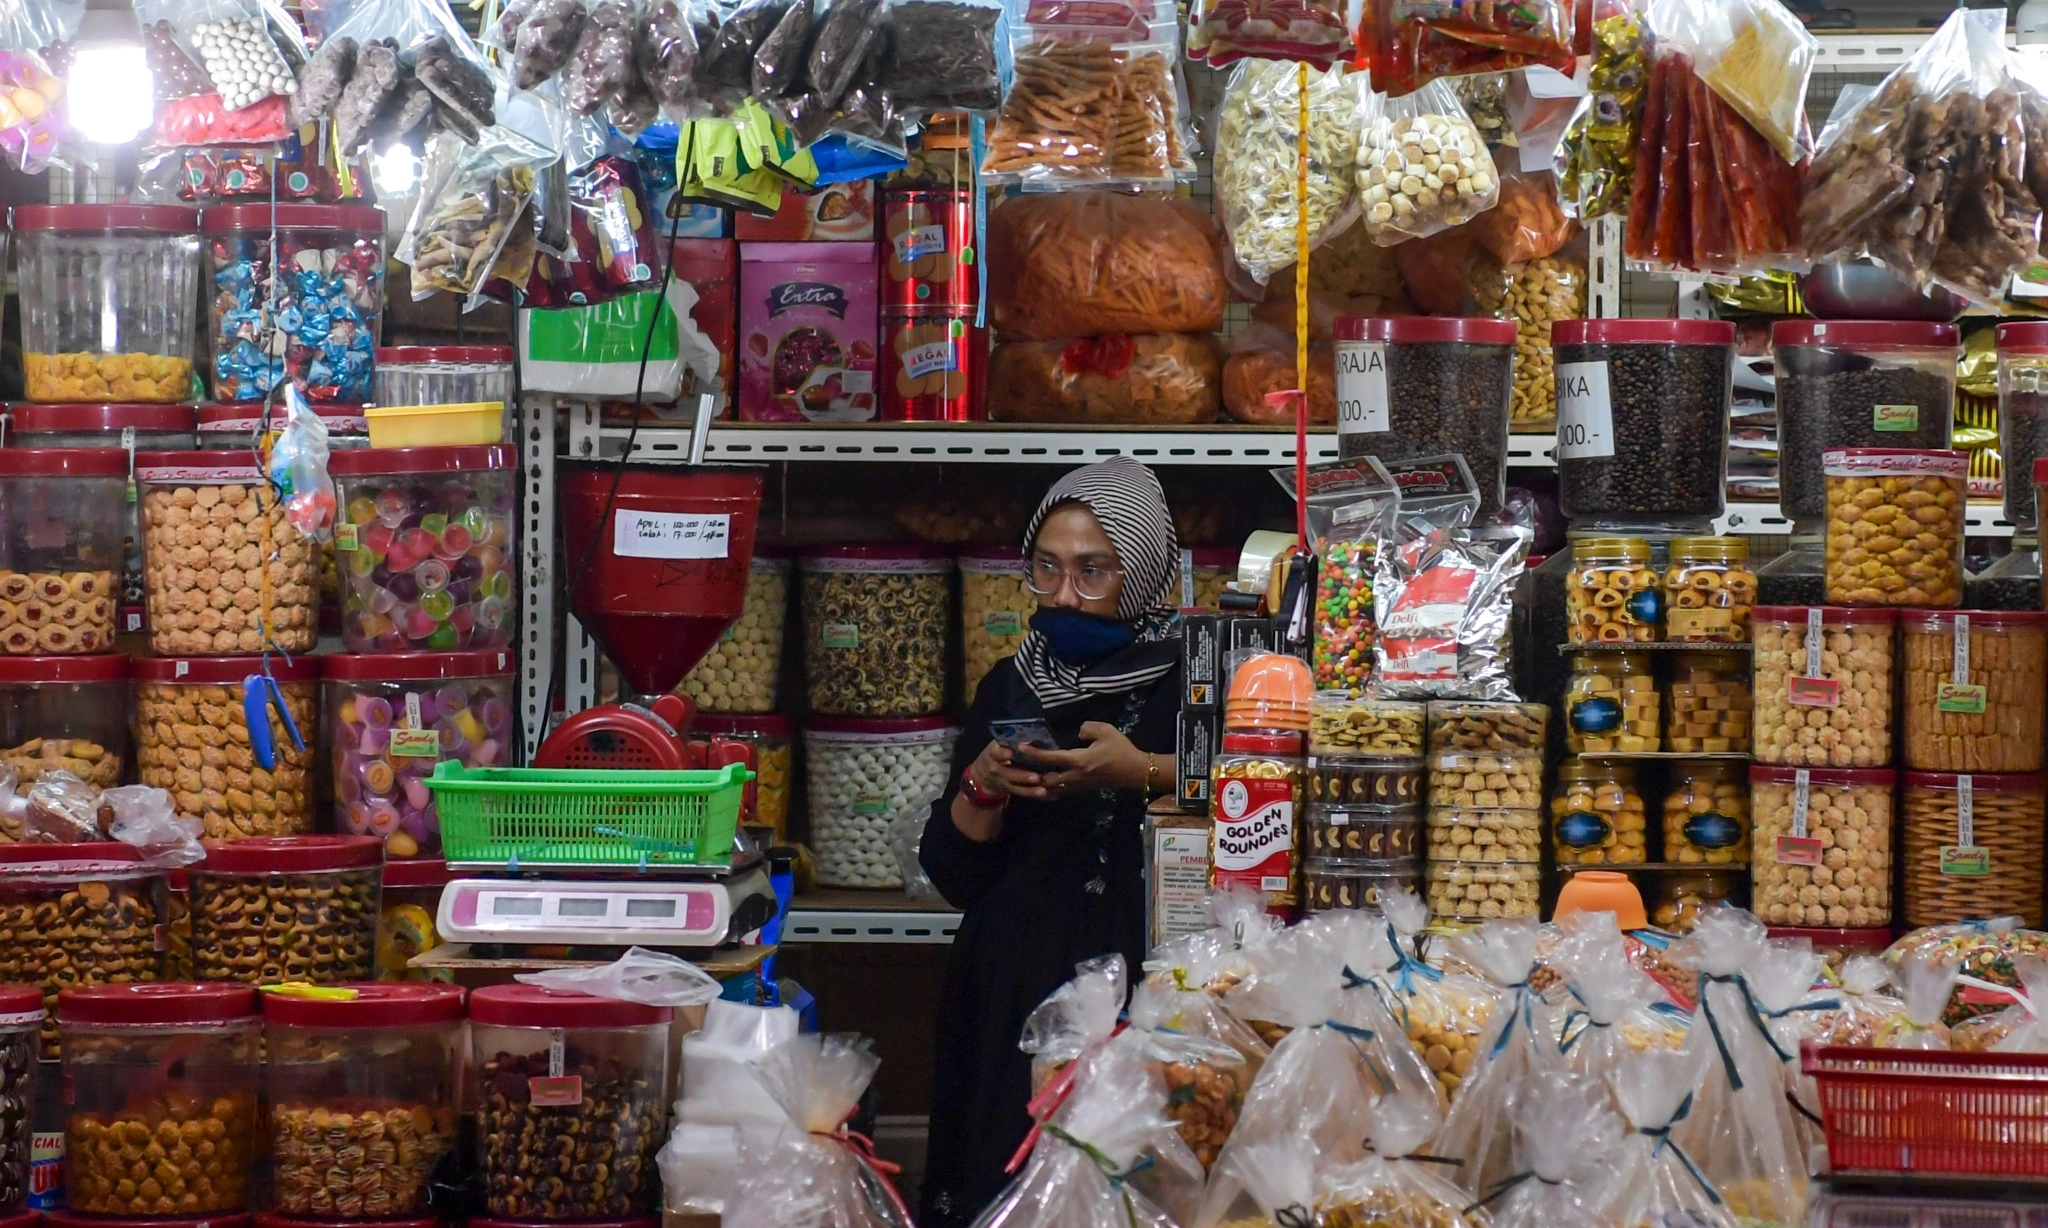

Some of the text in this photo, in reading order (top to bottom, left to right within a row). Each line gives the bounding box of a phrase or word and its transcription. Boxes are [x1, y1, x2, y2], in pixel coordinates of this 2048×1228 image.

[900, 232, 938, 249] REGAL
[780, 284, 837, 304] Extra
[909, 348, 950, 365] REGAL
[1878, 406, 1916, 422] Sandy
[1880, 458, 1917, 470] Sandy
[1917, 458, 1952, 470] Sandy
[176, 470, 214, 480] Sandy
[1391, 612, 1418, 624] Delfi
[1940, 686, 1982, 700] Sandy
[394, 731, 436, 745] Sandy
[1226, 808, 1282, 838] GOLDEN
[1219, 823, 1289, 855] ROUNDIES
[1946, 849, 1988, 863] Sandy
[34, 1137, 61, 1149] CIAL
